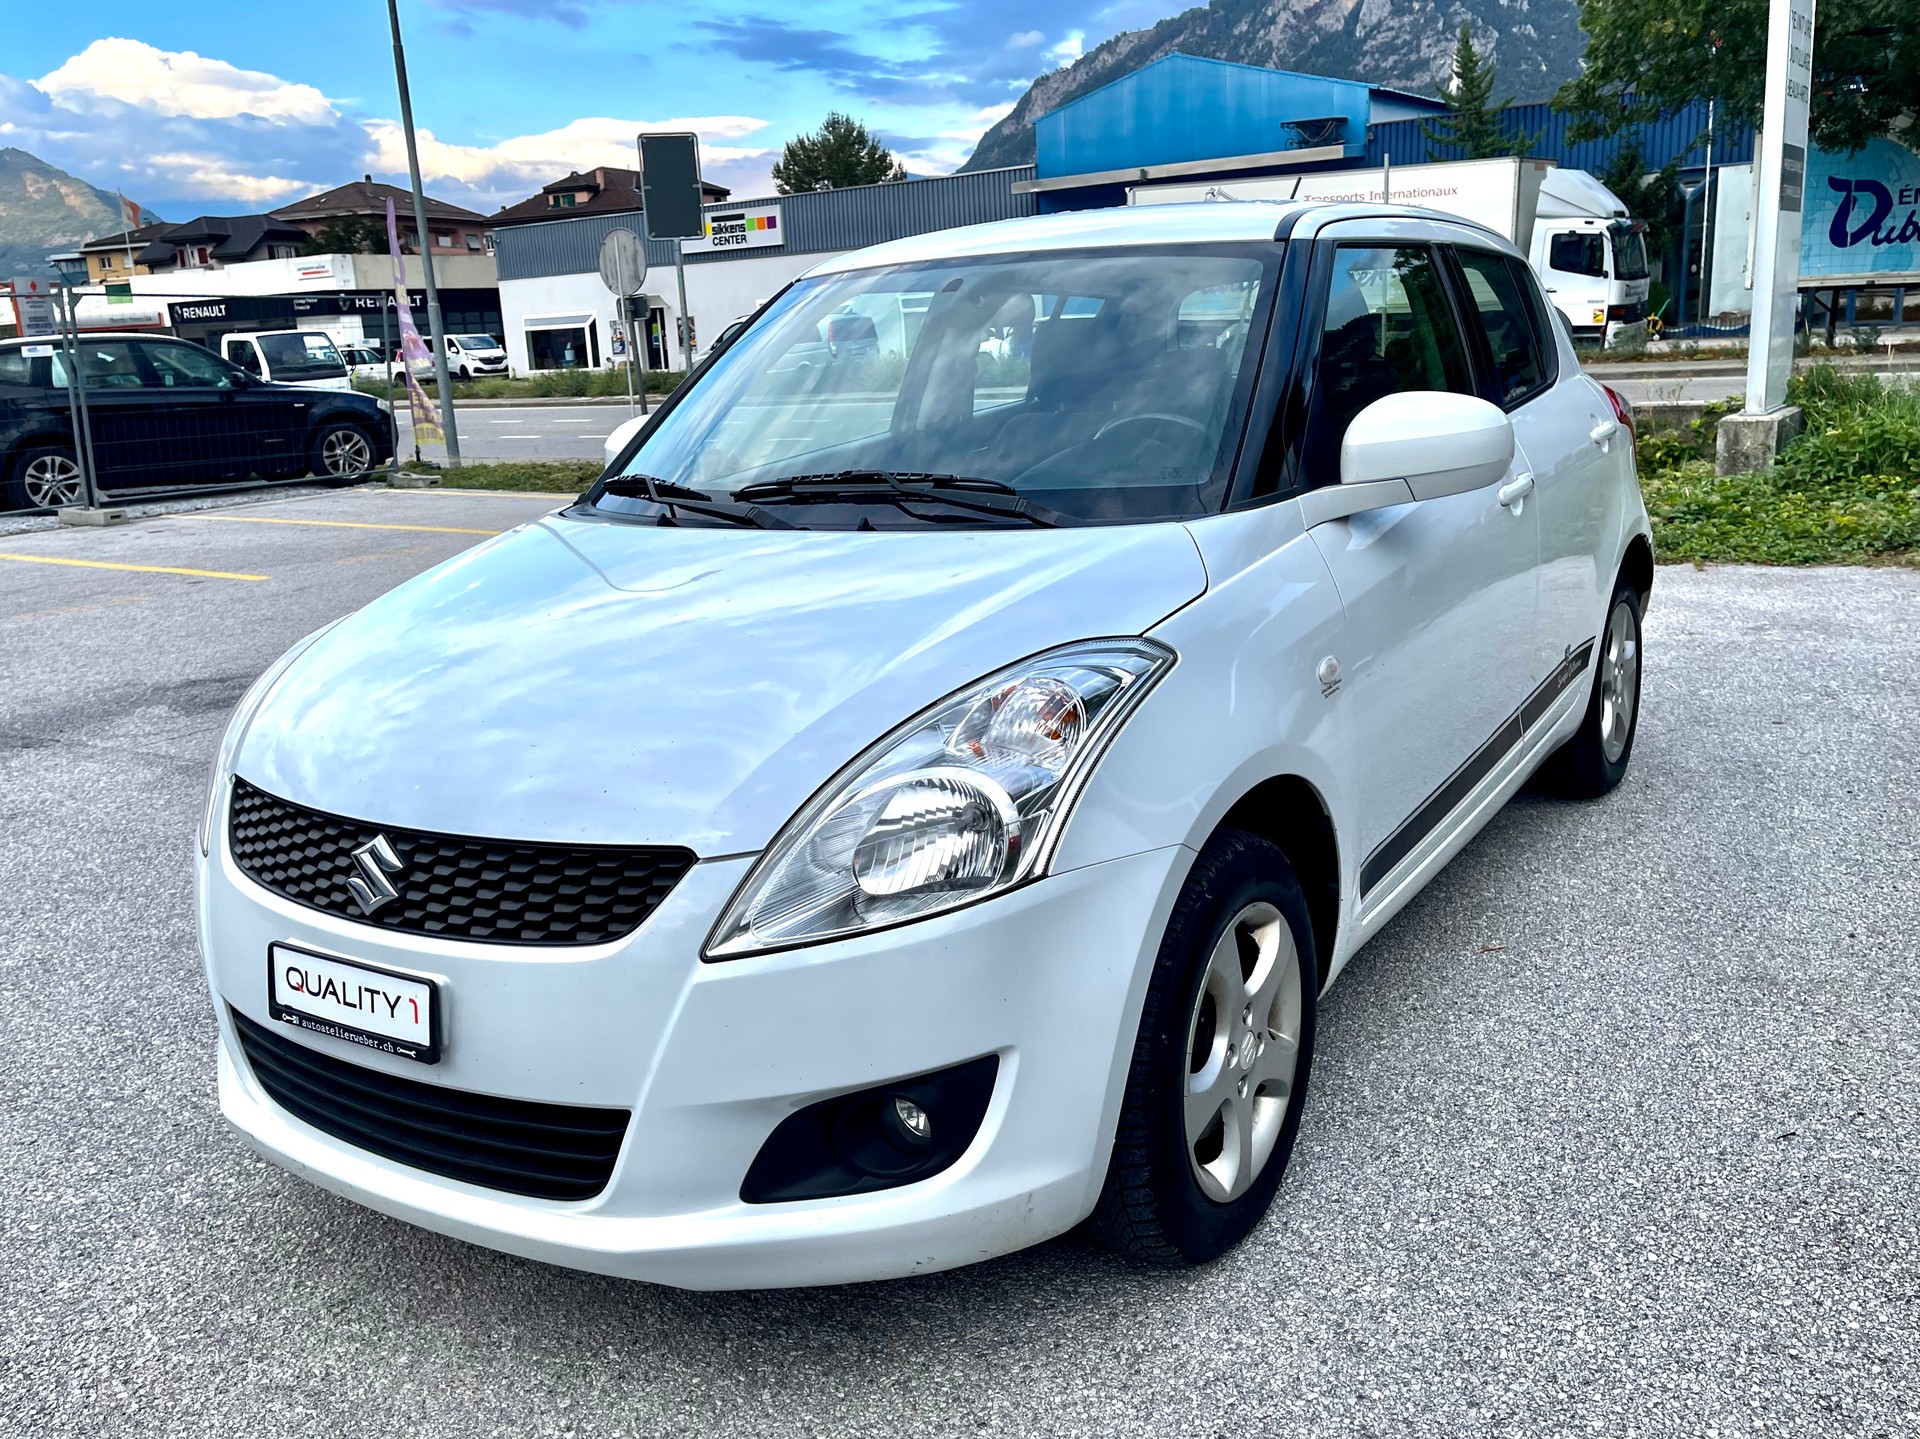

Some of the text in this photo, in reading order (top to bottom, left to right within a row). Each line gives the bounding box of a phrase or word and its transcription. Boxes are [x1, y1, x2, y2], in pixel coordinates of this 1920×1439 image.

[1369, 187, 1459, 202] Internationaux
[1827, 175, 1920, 248] Dub
[711, 223, 746, 236] sikkens
[712, 234, 747, 246] CENTER
[355, 295, 422, 308] REALT
[182, 304, 226, 319] RENAULT
[285, 966, 419, 1024] QUALITY 1
[301, 1018, 394, 1053] autoatelierweber.ch
